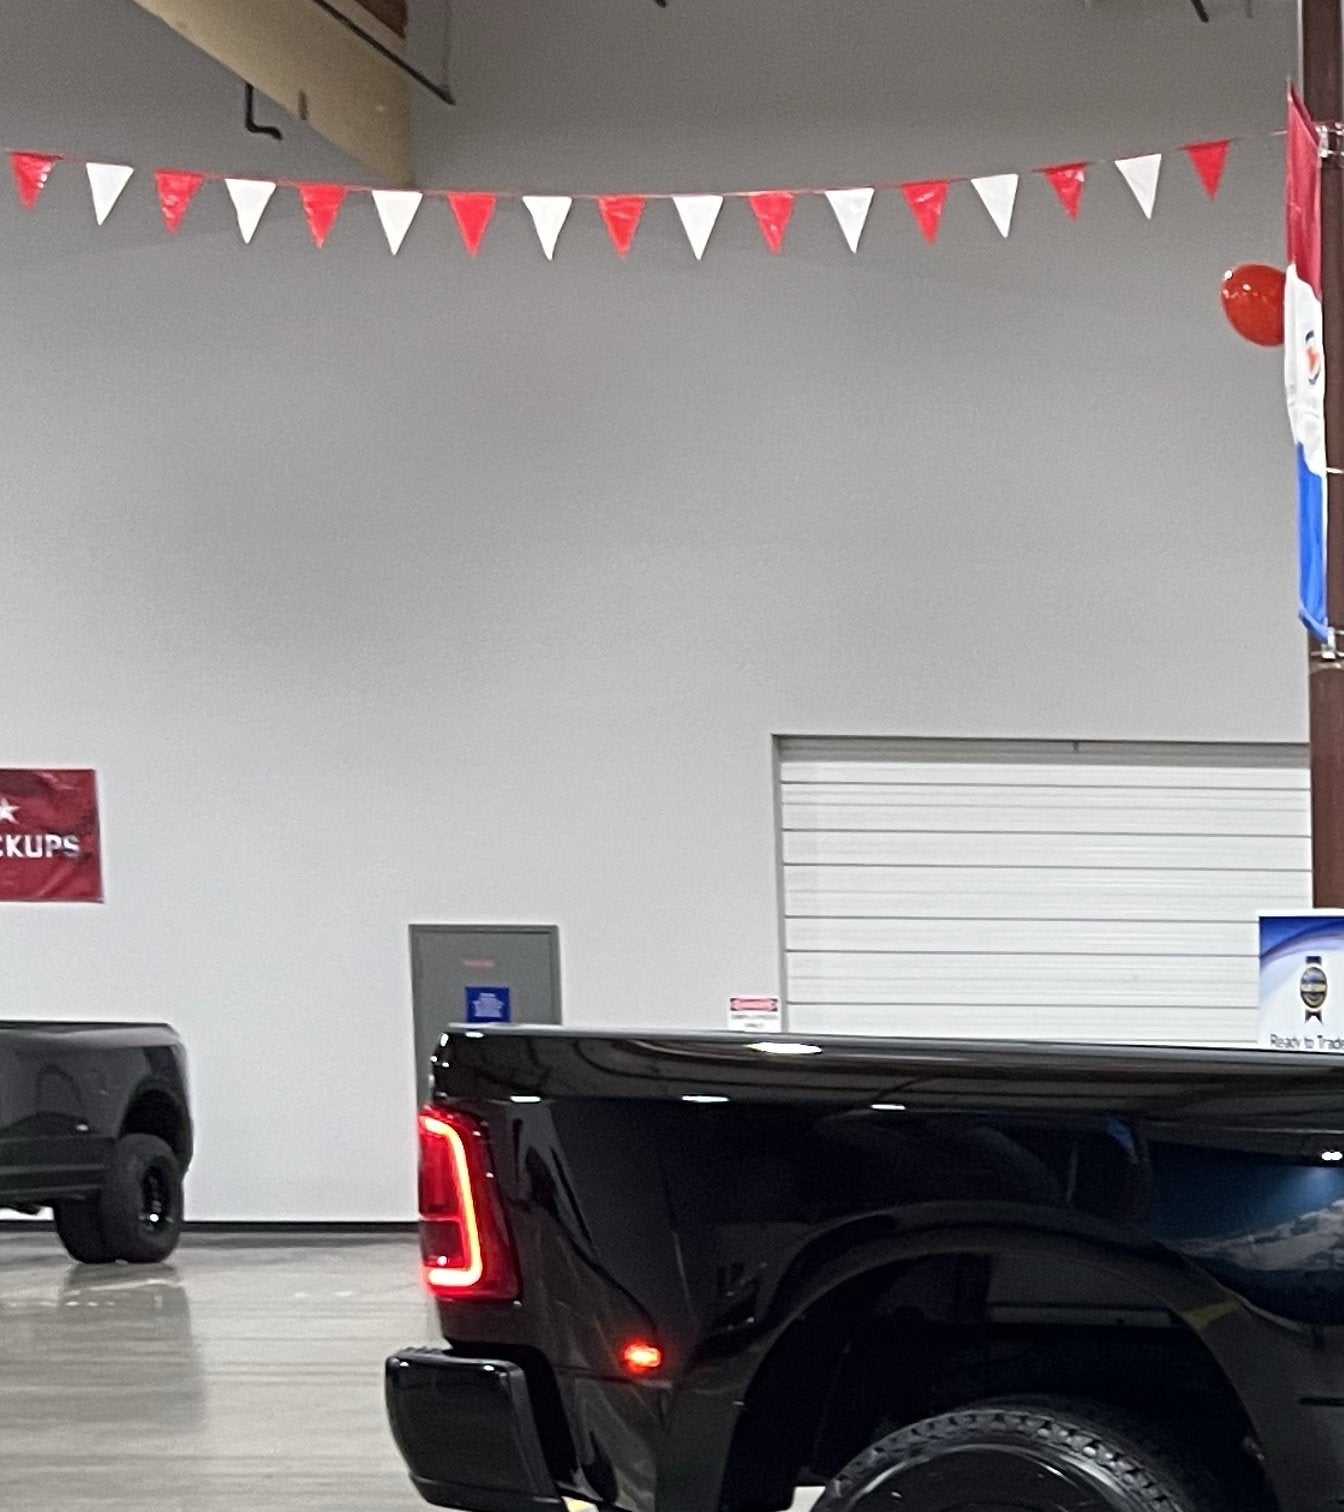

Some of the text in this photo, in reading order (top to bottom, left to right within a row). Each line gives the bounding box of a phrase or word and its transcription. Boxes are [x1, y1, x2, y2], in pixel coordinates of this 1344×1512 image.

[0, 833, 81, 859] KUPS
[1269, 1033, 1301, 1049] Ready
[1303, 1036, 1315, 1049] to
